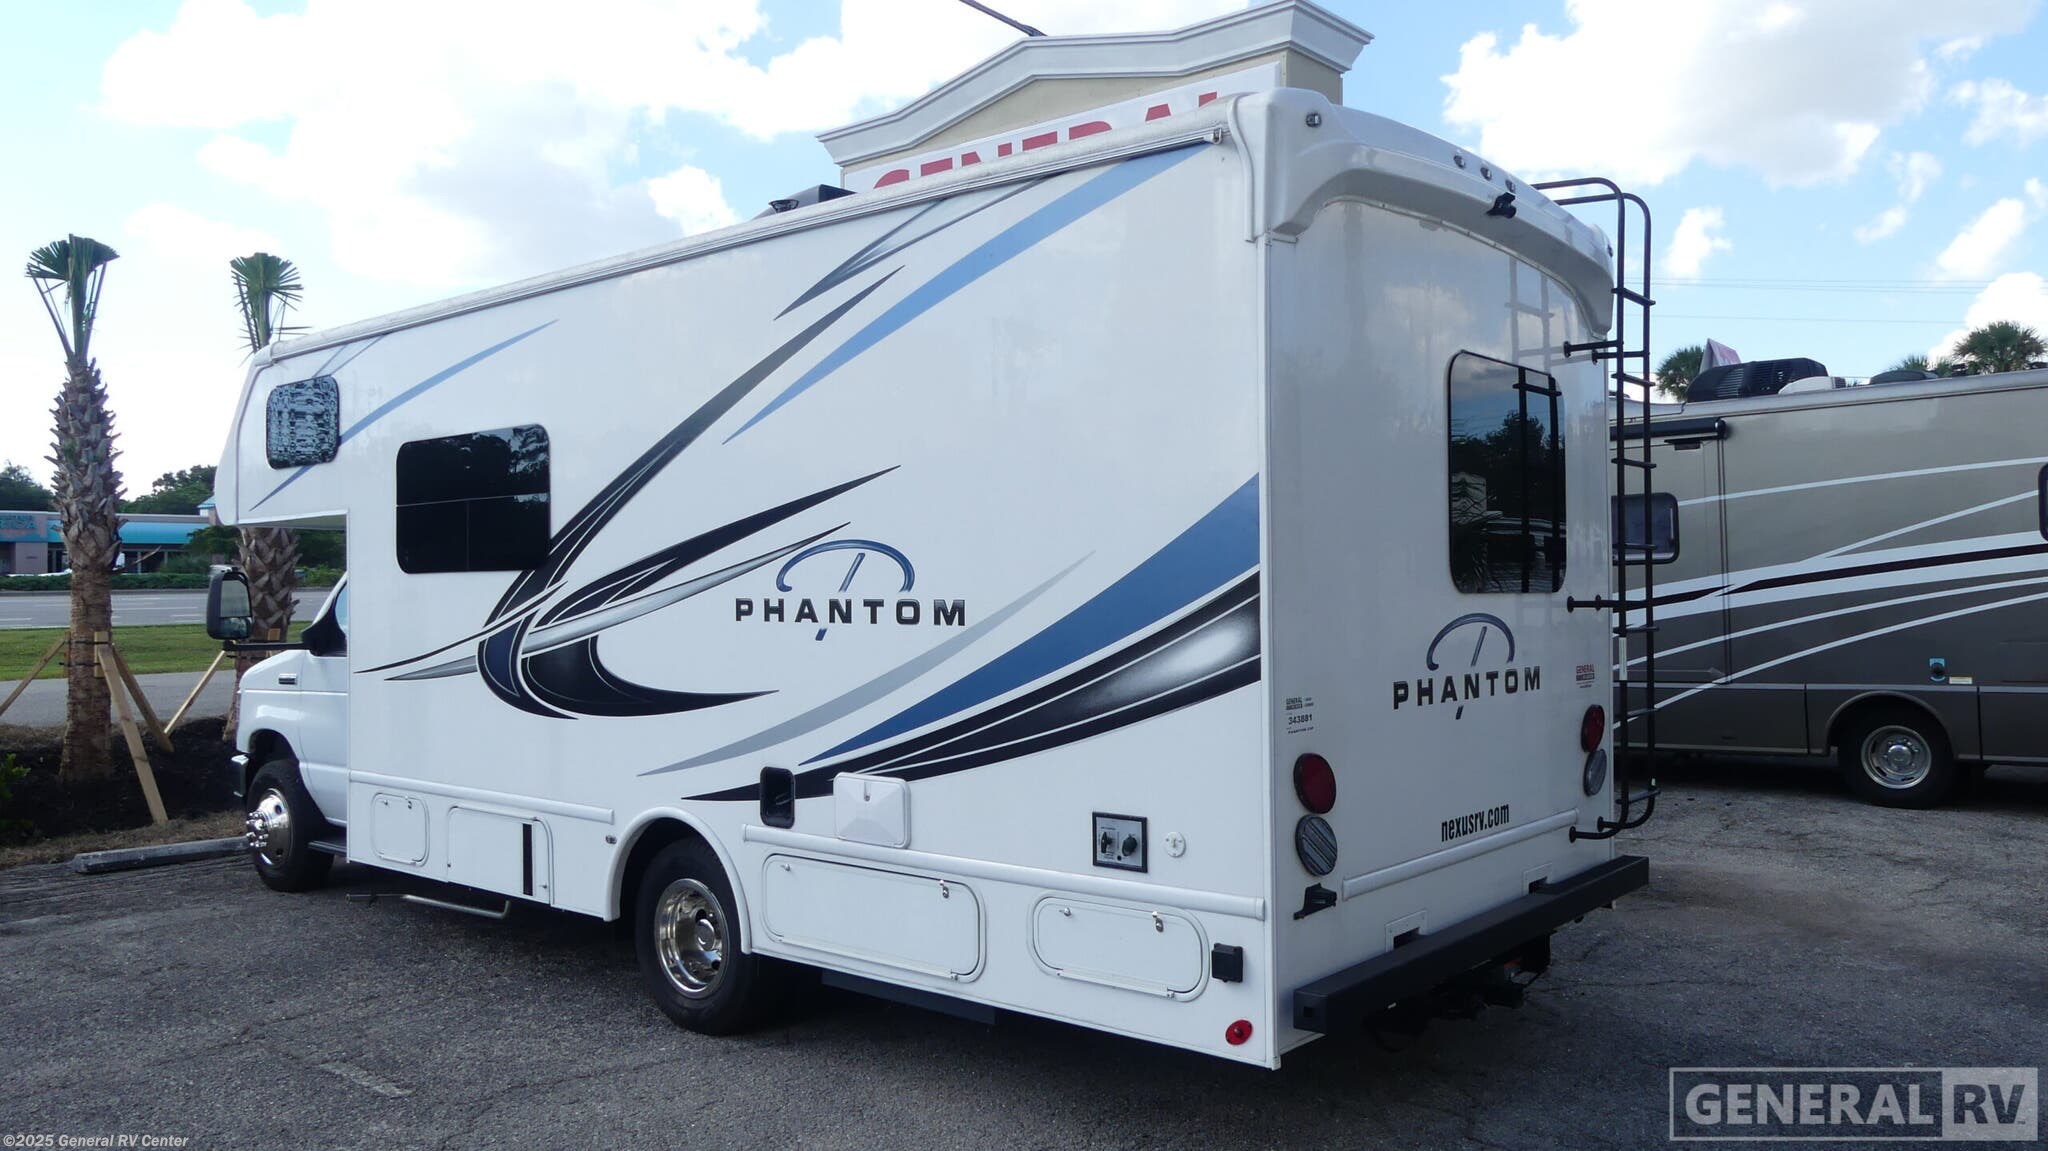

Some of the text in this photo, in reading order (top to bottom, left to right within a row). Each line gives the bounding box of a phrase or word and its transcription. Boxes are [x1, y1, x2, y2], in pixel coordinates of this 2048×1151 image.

[735, 598, 966, 627] PHANTOM
[1393, 666, 1541, 710] PHANTOM
[1441, 803, 1510, 842] nexusrv.com
